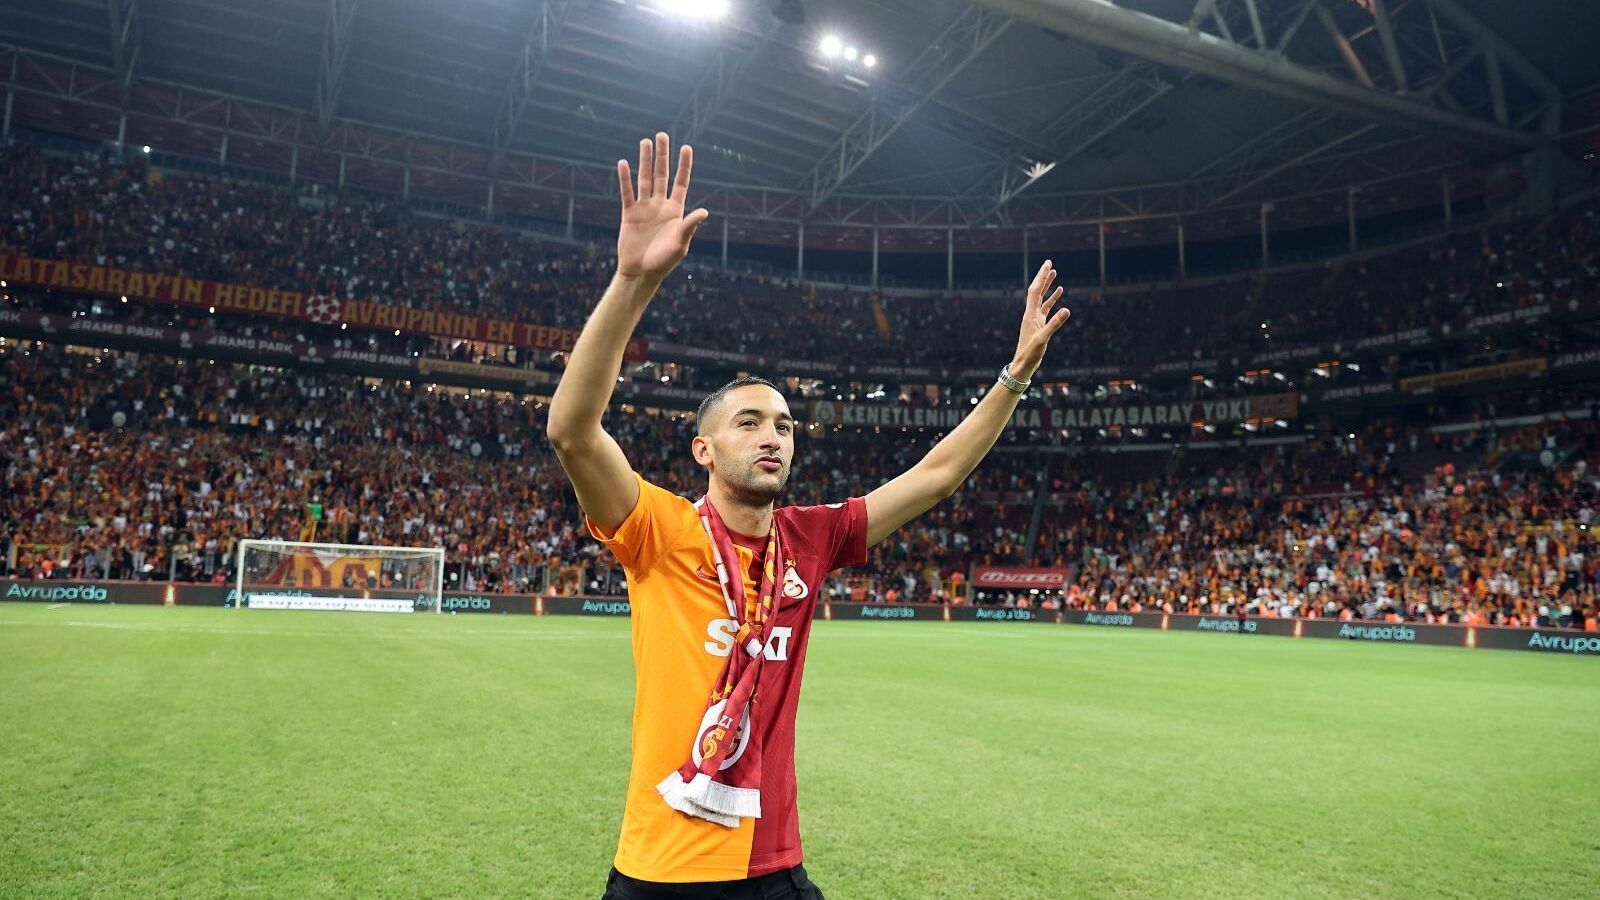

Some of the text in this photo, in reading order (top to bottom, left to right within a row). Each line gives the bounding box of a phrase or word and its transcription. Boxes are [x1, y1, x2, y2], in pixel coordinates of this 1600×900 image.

[81, 320, 164, 339] RAMS PARK
[487, 319, 514, 342] EN
[219, 335, 294, 353] RAMS PARK
[341, 351, 381, 364] RAMS
[382, 354, 412, 367] PARK
[1051, 403, 1193, 427] GALATASARAY
[1203, 400, 1250, 421] YOK!
[7, 583, 108, 601] Avrupa'da
[415, 594, 491, 610] Avupa'da
[1338, 623, 1417, 641] Avrupa'da
